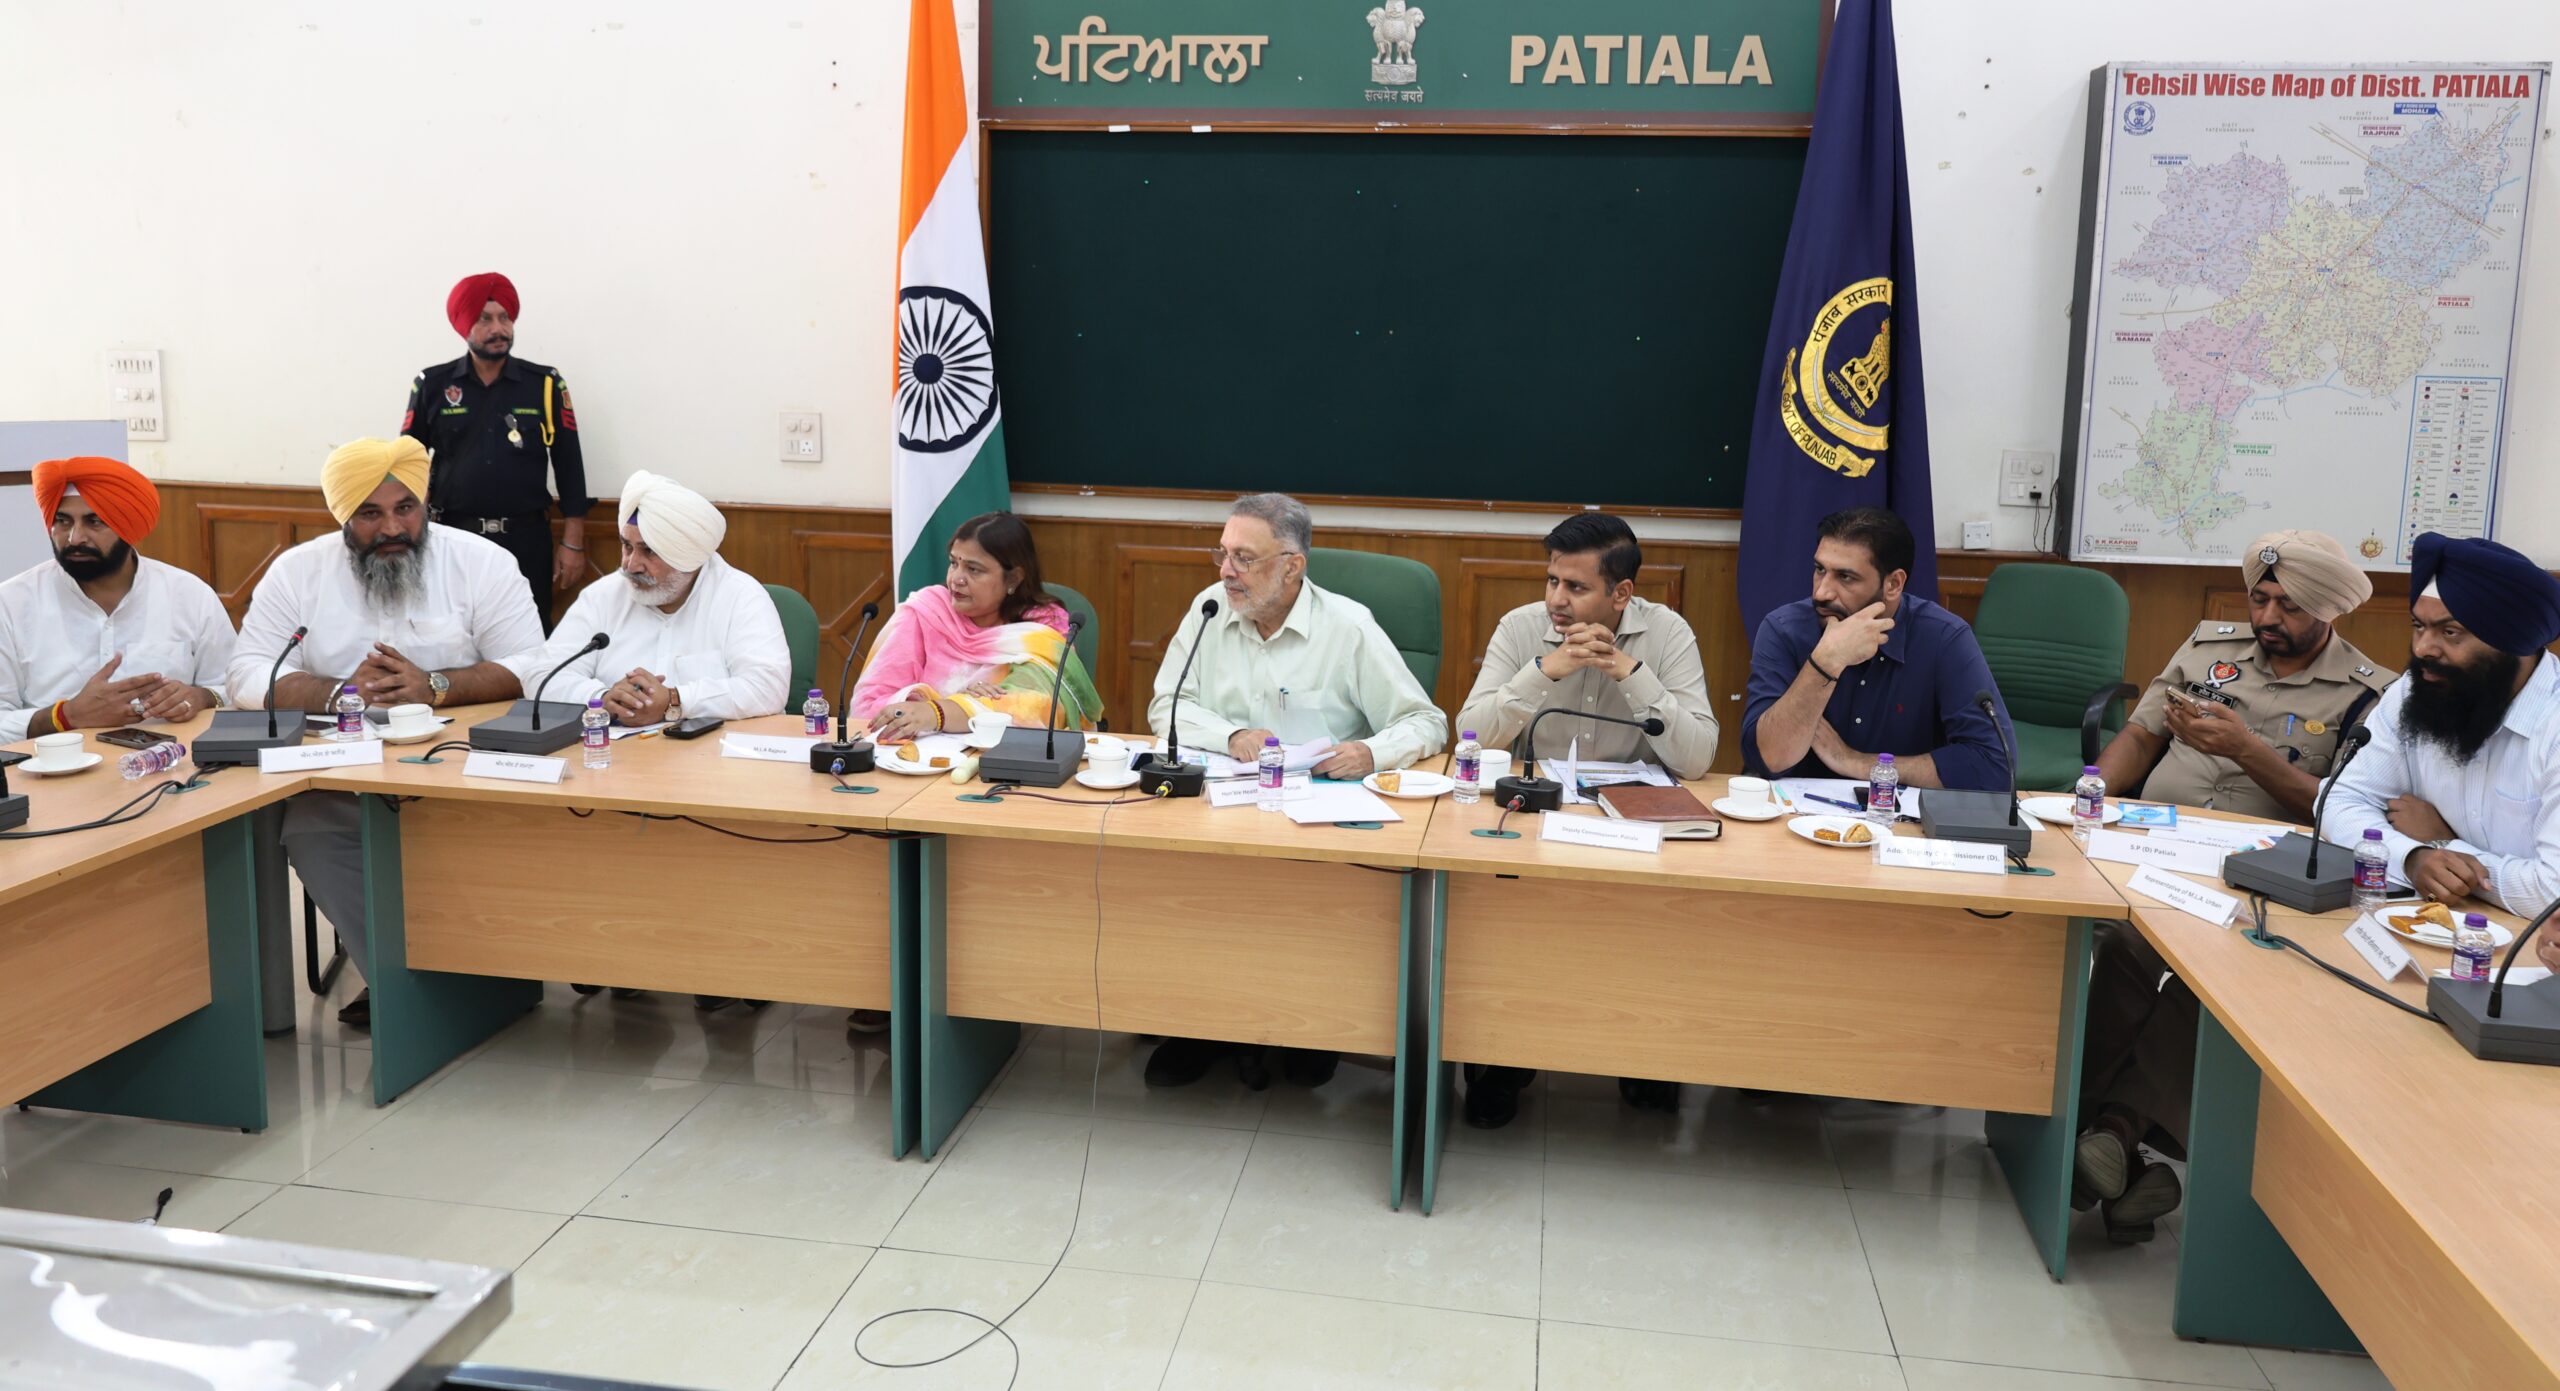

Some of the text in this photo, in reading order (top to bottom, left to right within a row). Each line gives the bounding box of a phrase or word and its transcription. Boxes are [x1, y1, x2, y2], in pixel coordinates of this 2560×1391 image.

[1034, 15, 1268, 83] ਪਟਿਆਲਾ
[1510, 35, 1773, 85] PATIALA
[1364, 86, 1424, 103] सत्यमेव जयते
[2123, 73, 2530, 100] Tehsil Wise Map of Distt. PATIALA
[1813, 284, 1887, 343] पंजाब सरकार
[1782, 393, 1837, 465] GOVT. OF PUNJAB
[2154, 848, 2177, 857] Patiala
[2144, 874, 2183, 895] Representative
[2205, 899, 2222, 909] Urban
